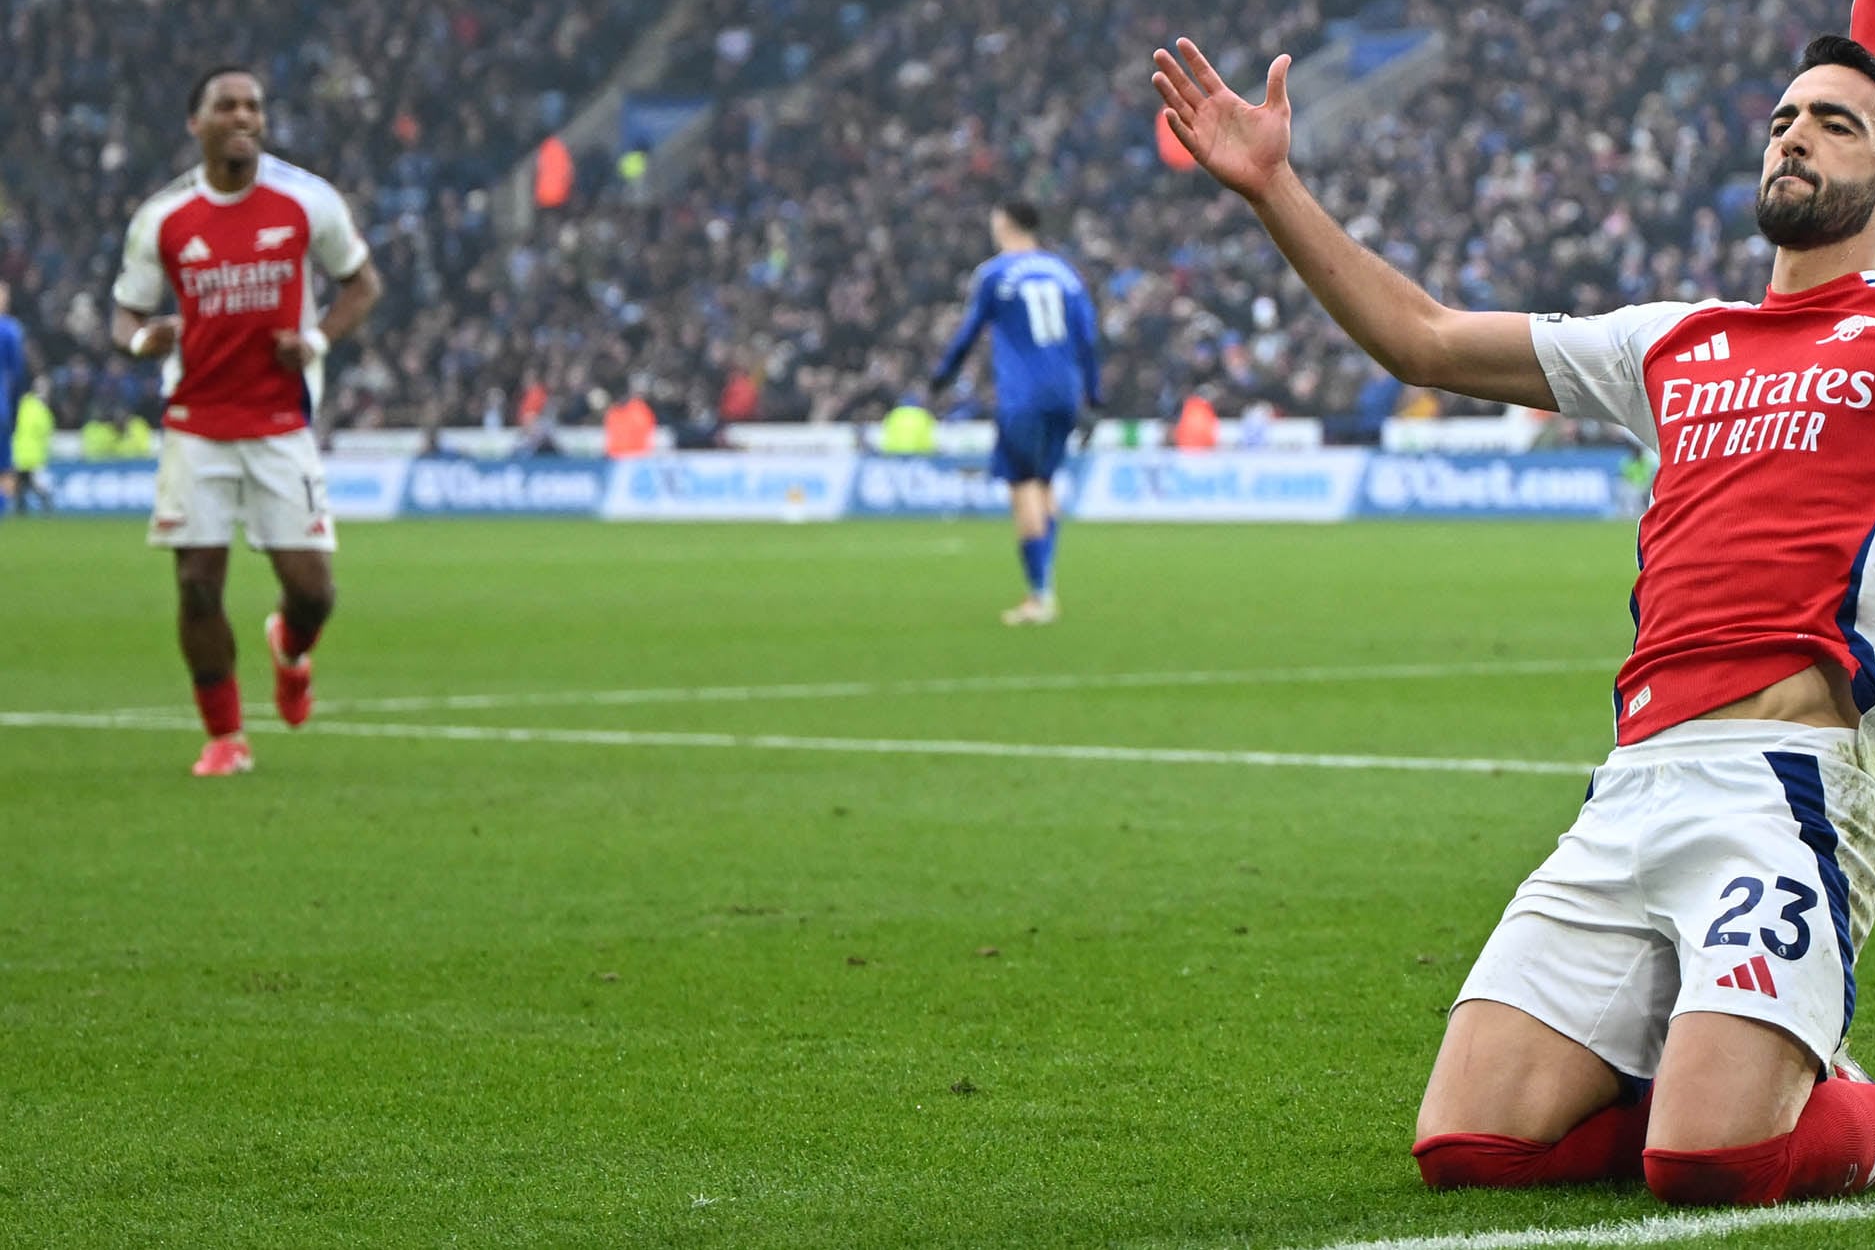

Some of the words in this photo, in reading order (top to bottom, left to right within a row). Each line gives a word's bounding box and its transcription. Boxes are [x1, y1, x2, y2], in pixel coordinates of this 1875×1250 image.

[179, 259, 295, 297] Emirates
[1020, 279, 1068, 348] 11
[1661, 363, 1875, 426] Emirates
[1673, 421, 1723, 465] FLY
[1723, 411, 1826, 457] BETTER
[1703, 875, 1818, 961] 23
